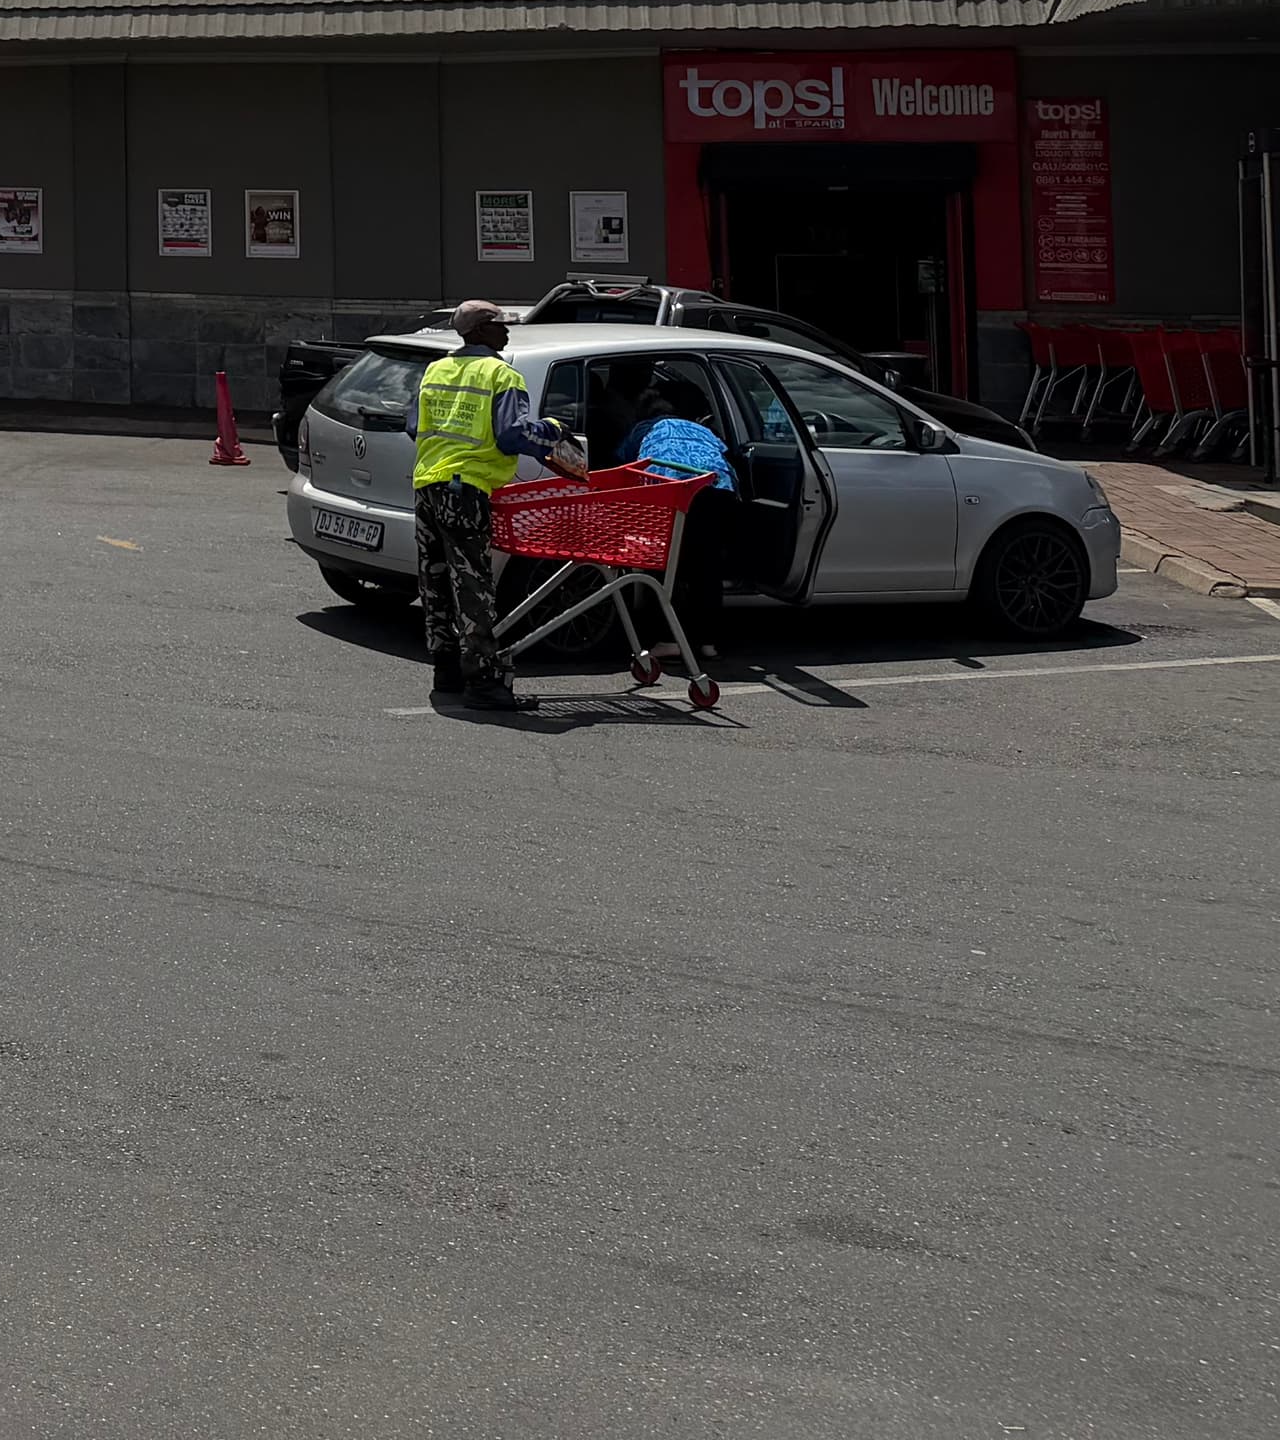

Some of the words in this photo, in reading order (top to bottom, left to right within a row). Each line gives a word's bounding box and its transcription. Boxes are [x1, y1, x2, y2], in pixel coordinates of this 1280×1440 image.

[679, 66, 844, 129] tops!
[872, 77, 995, 117] Welcome
[1035, 98, 1102, 125] tops!
[768, 119, 782, 129] at
[794, 120, 831, 128] SPAR
[267, 210, 292, 222] WIN
[319, 512, 332, 531] DJ
[333, 516, 345, 535] 56
[347, 520, 361, 539] RB
[365, 524, 380, 543] GP
